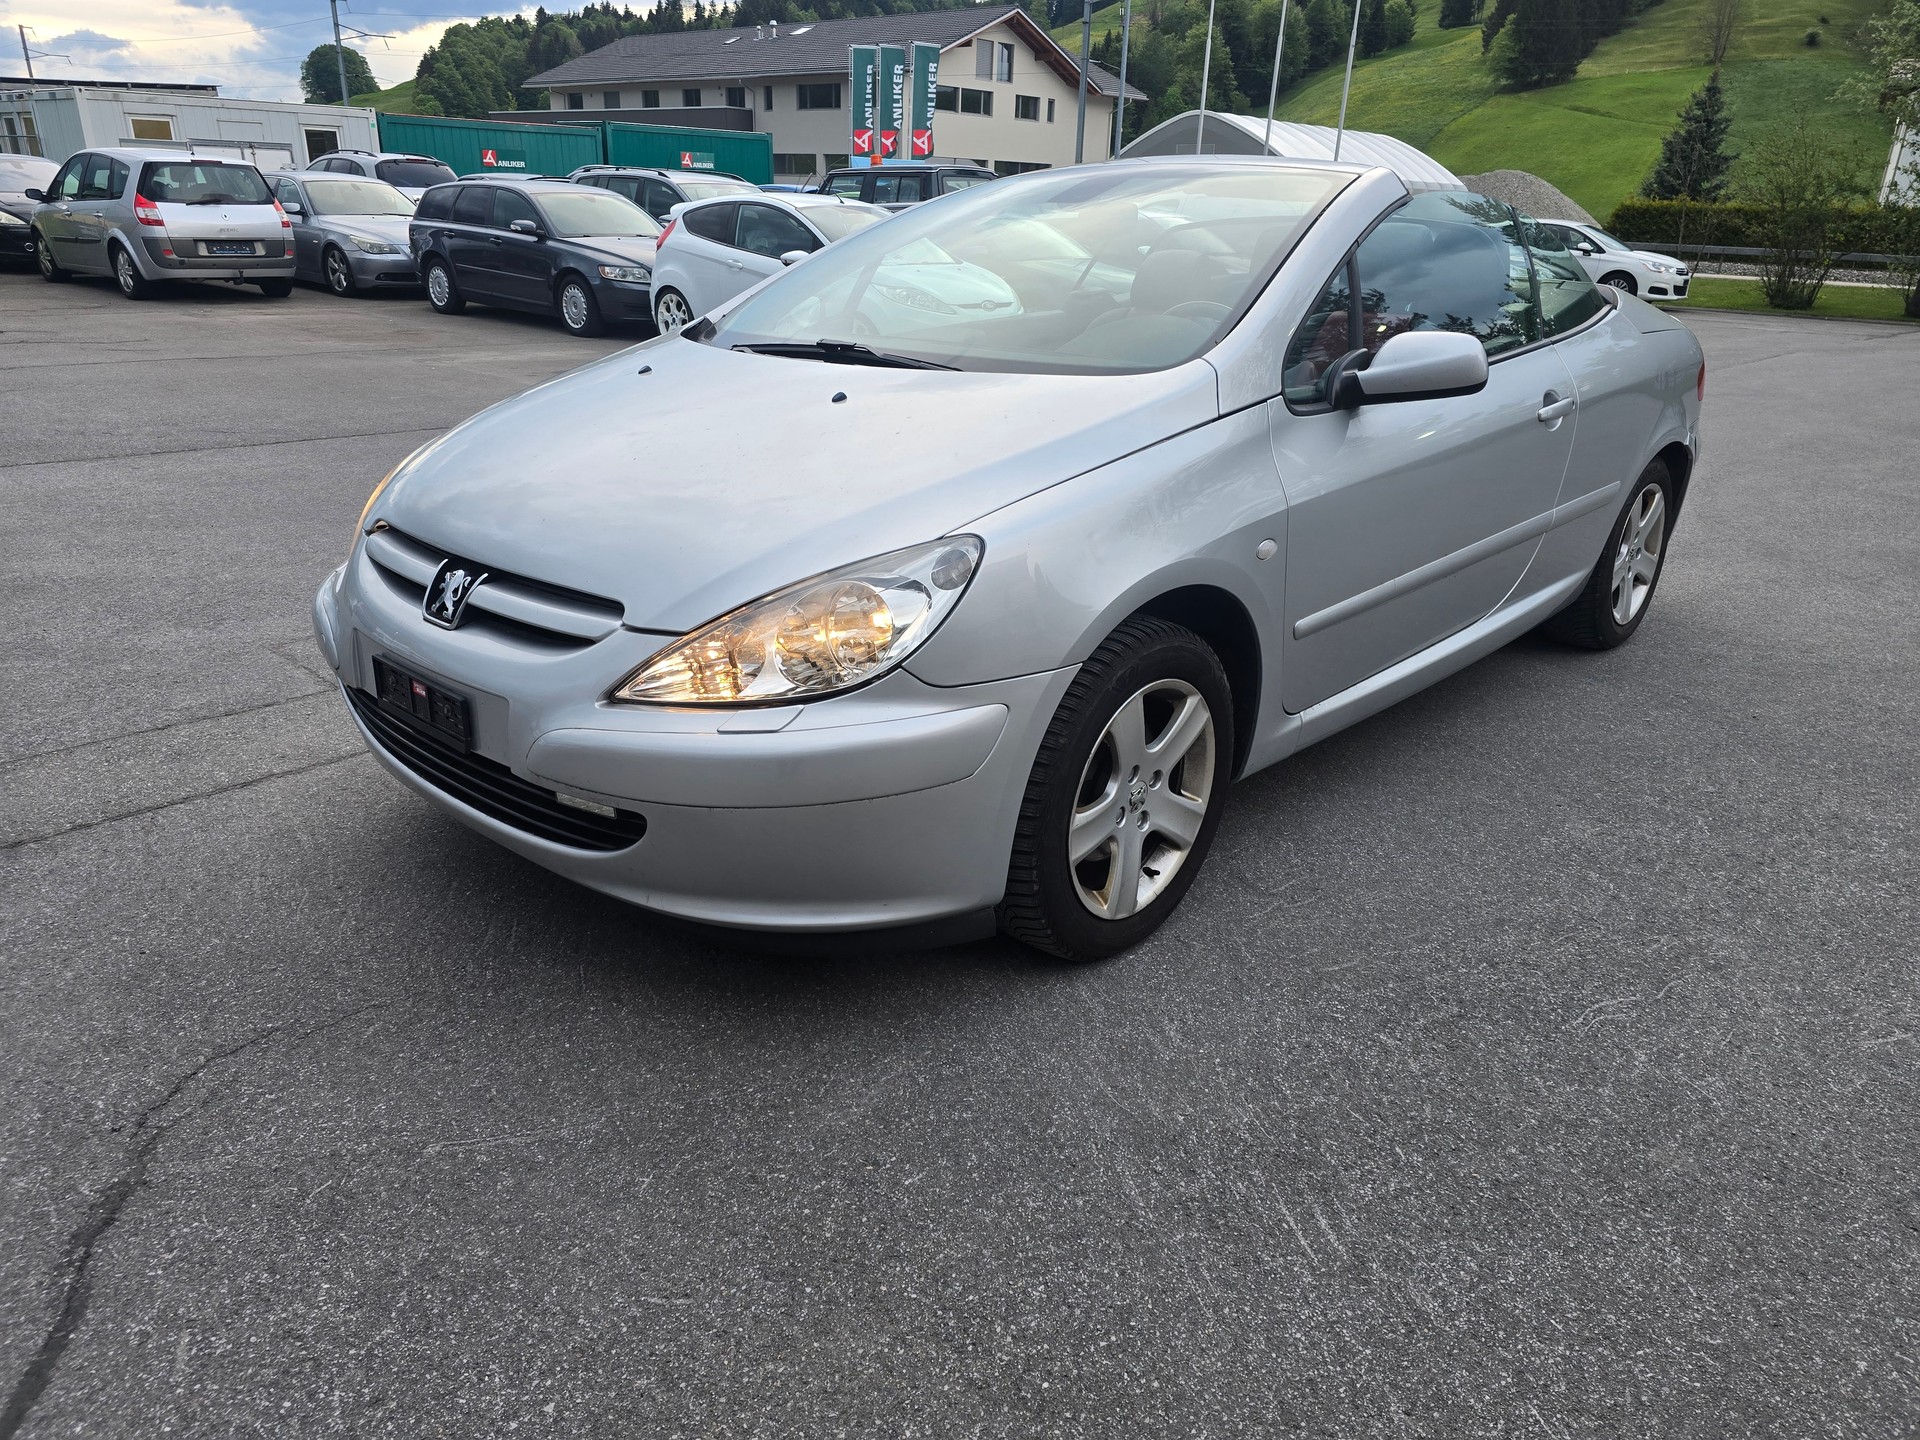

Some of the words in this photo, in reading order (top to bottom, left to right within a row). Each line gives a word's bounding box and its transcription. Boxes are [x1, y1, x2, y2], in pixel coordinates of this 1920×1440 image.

[865, 64, 873, 128] ANLIKER
[893, 64, 904, 129] ANLIKER
[926, 62, 937, 128] ANLIKER
[498, 160, 526, 168] ANLIKER
